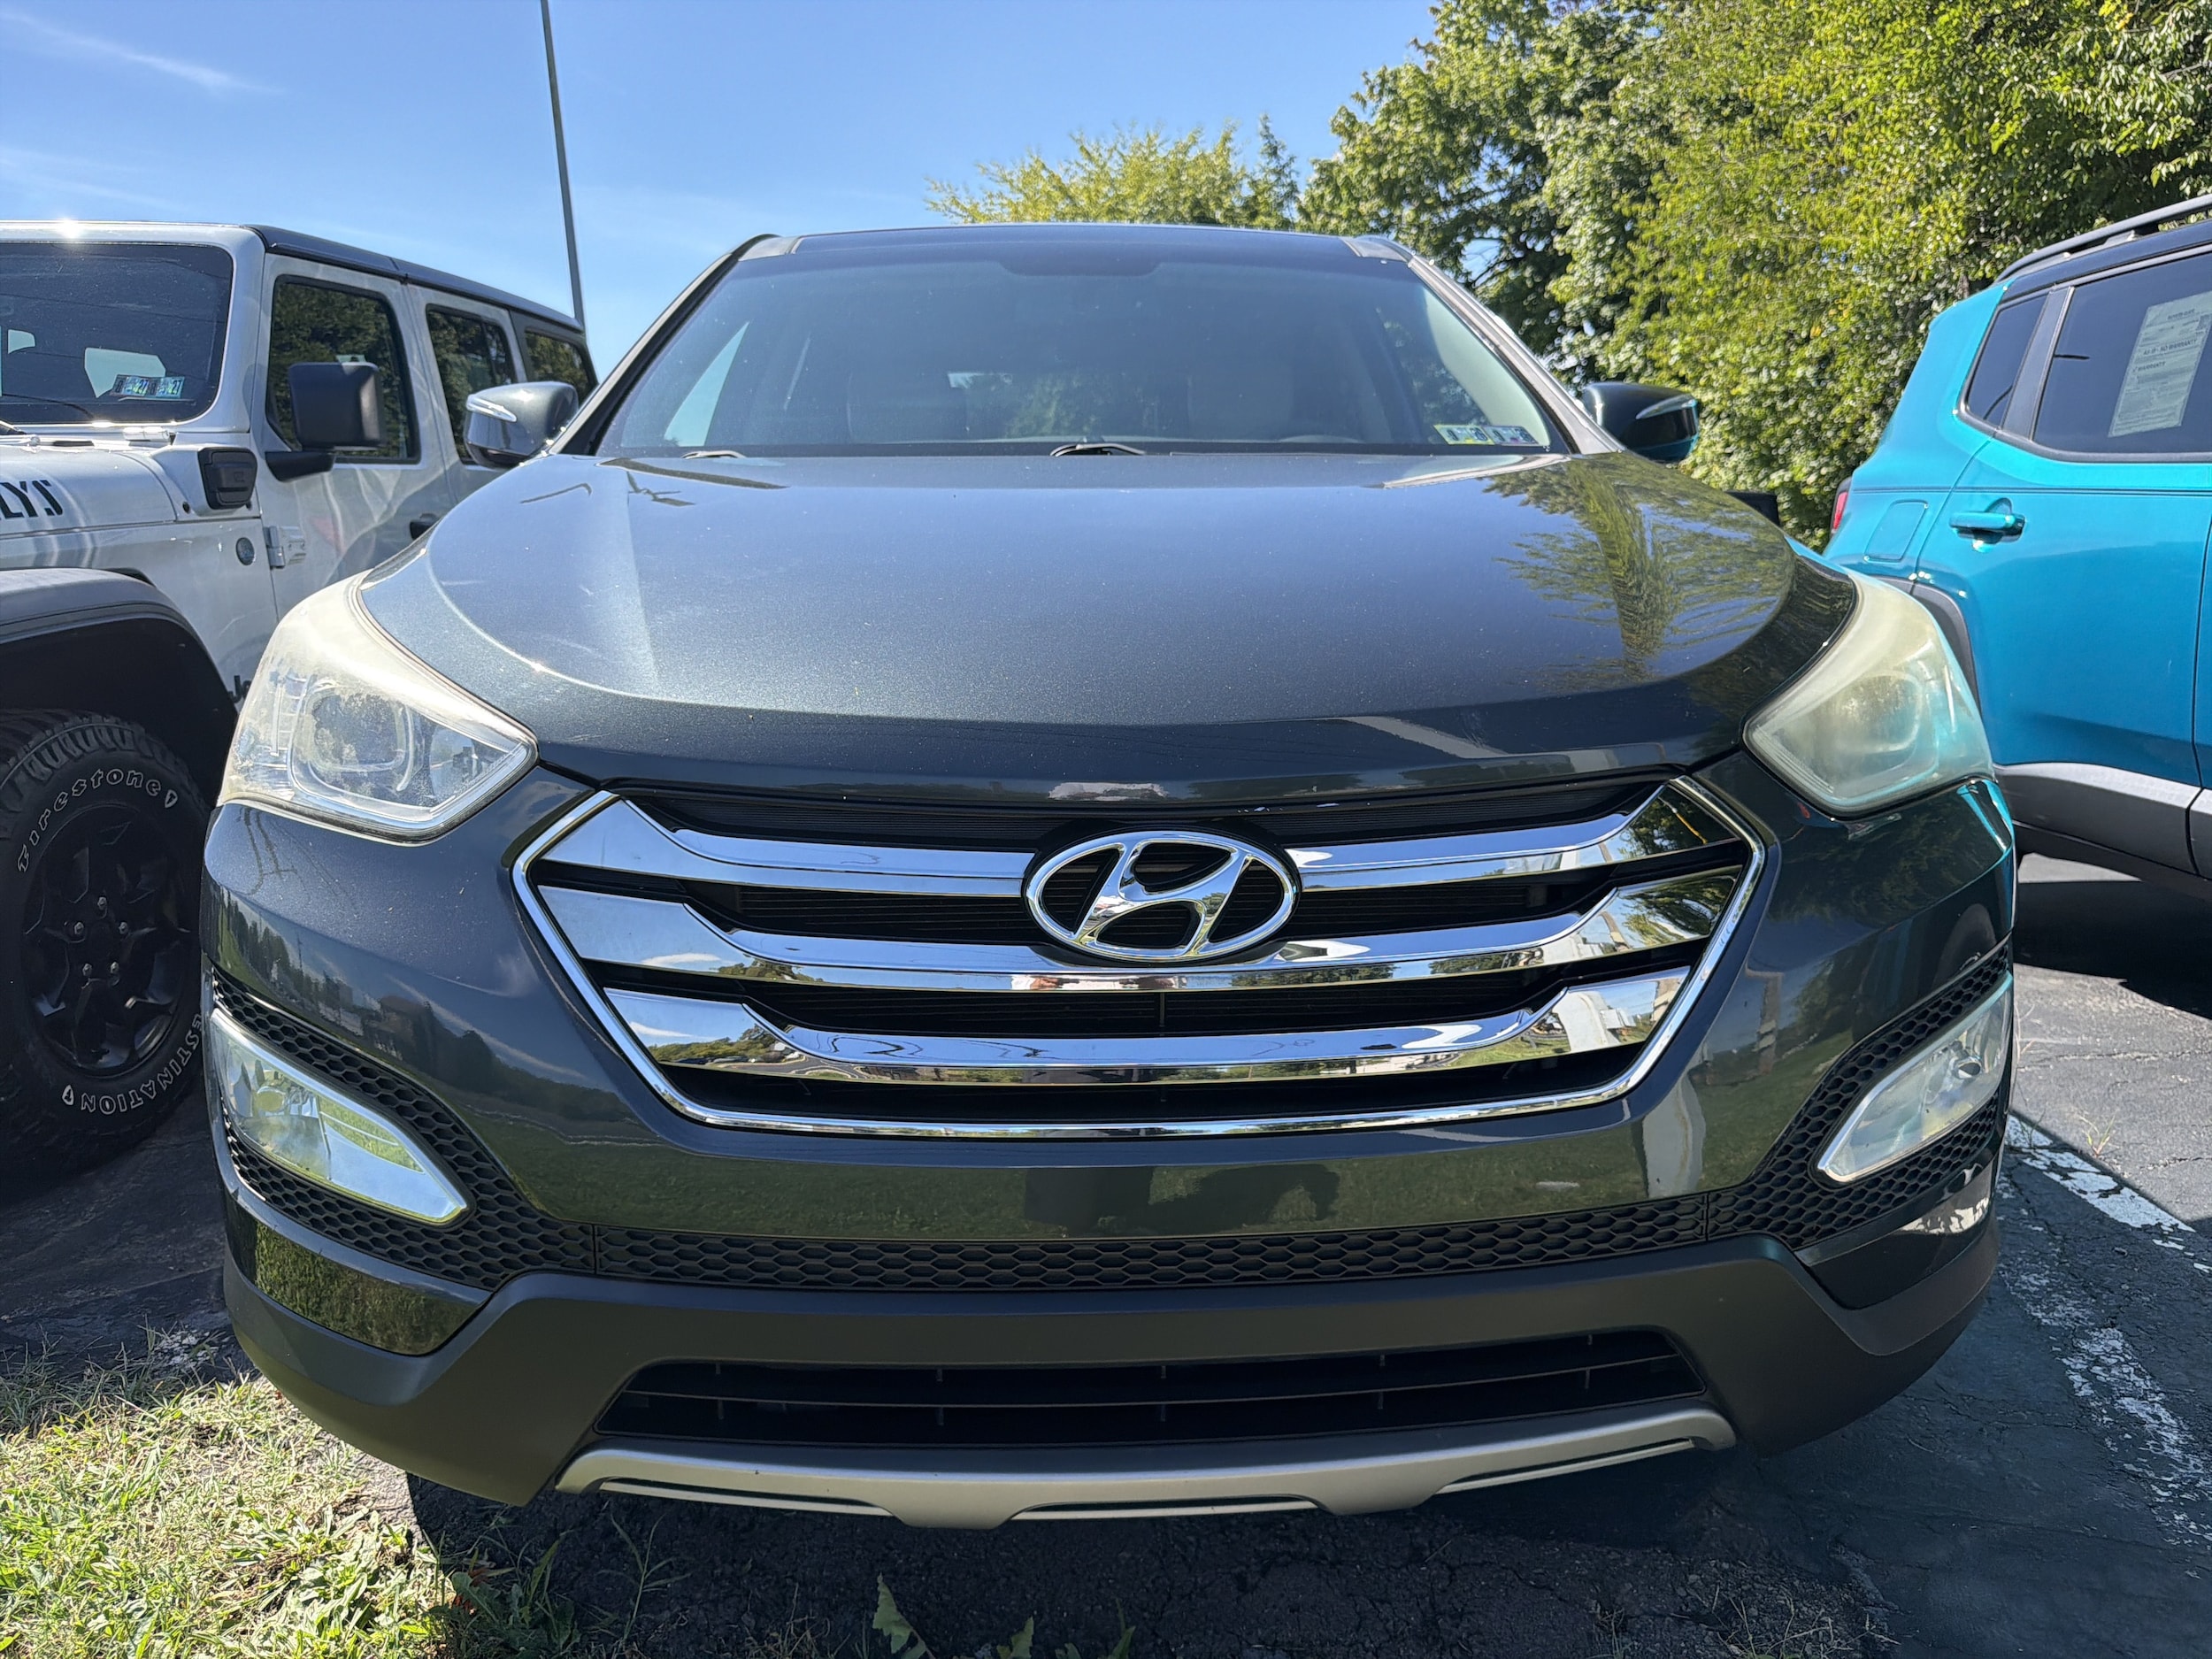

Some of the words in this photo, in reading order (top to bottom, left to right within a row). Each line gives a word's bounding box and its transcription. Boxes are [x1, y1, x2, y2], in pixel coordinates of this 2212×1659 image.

[136, 379, 149, 395] 27
[171, 380, 182, 396] 27
[17, 768, 162, 873] Firestone
